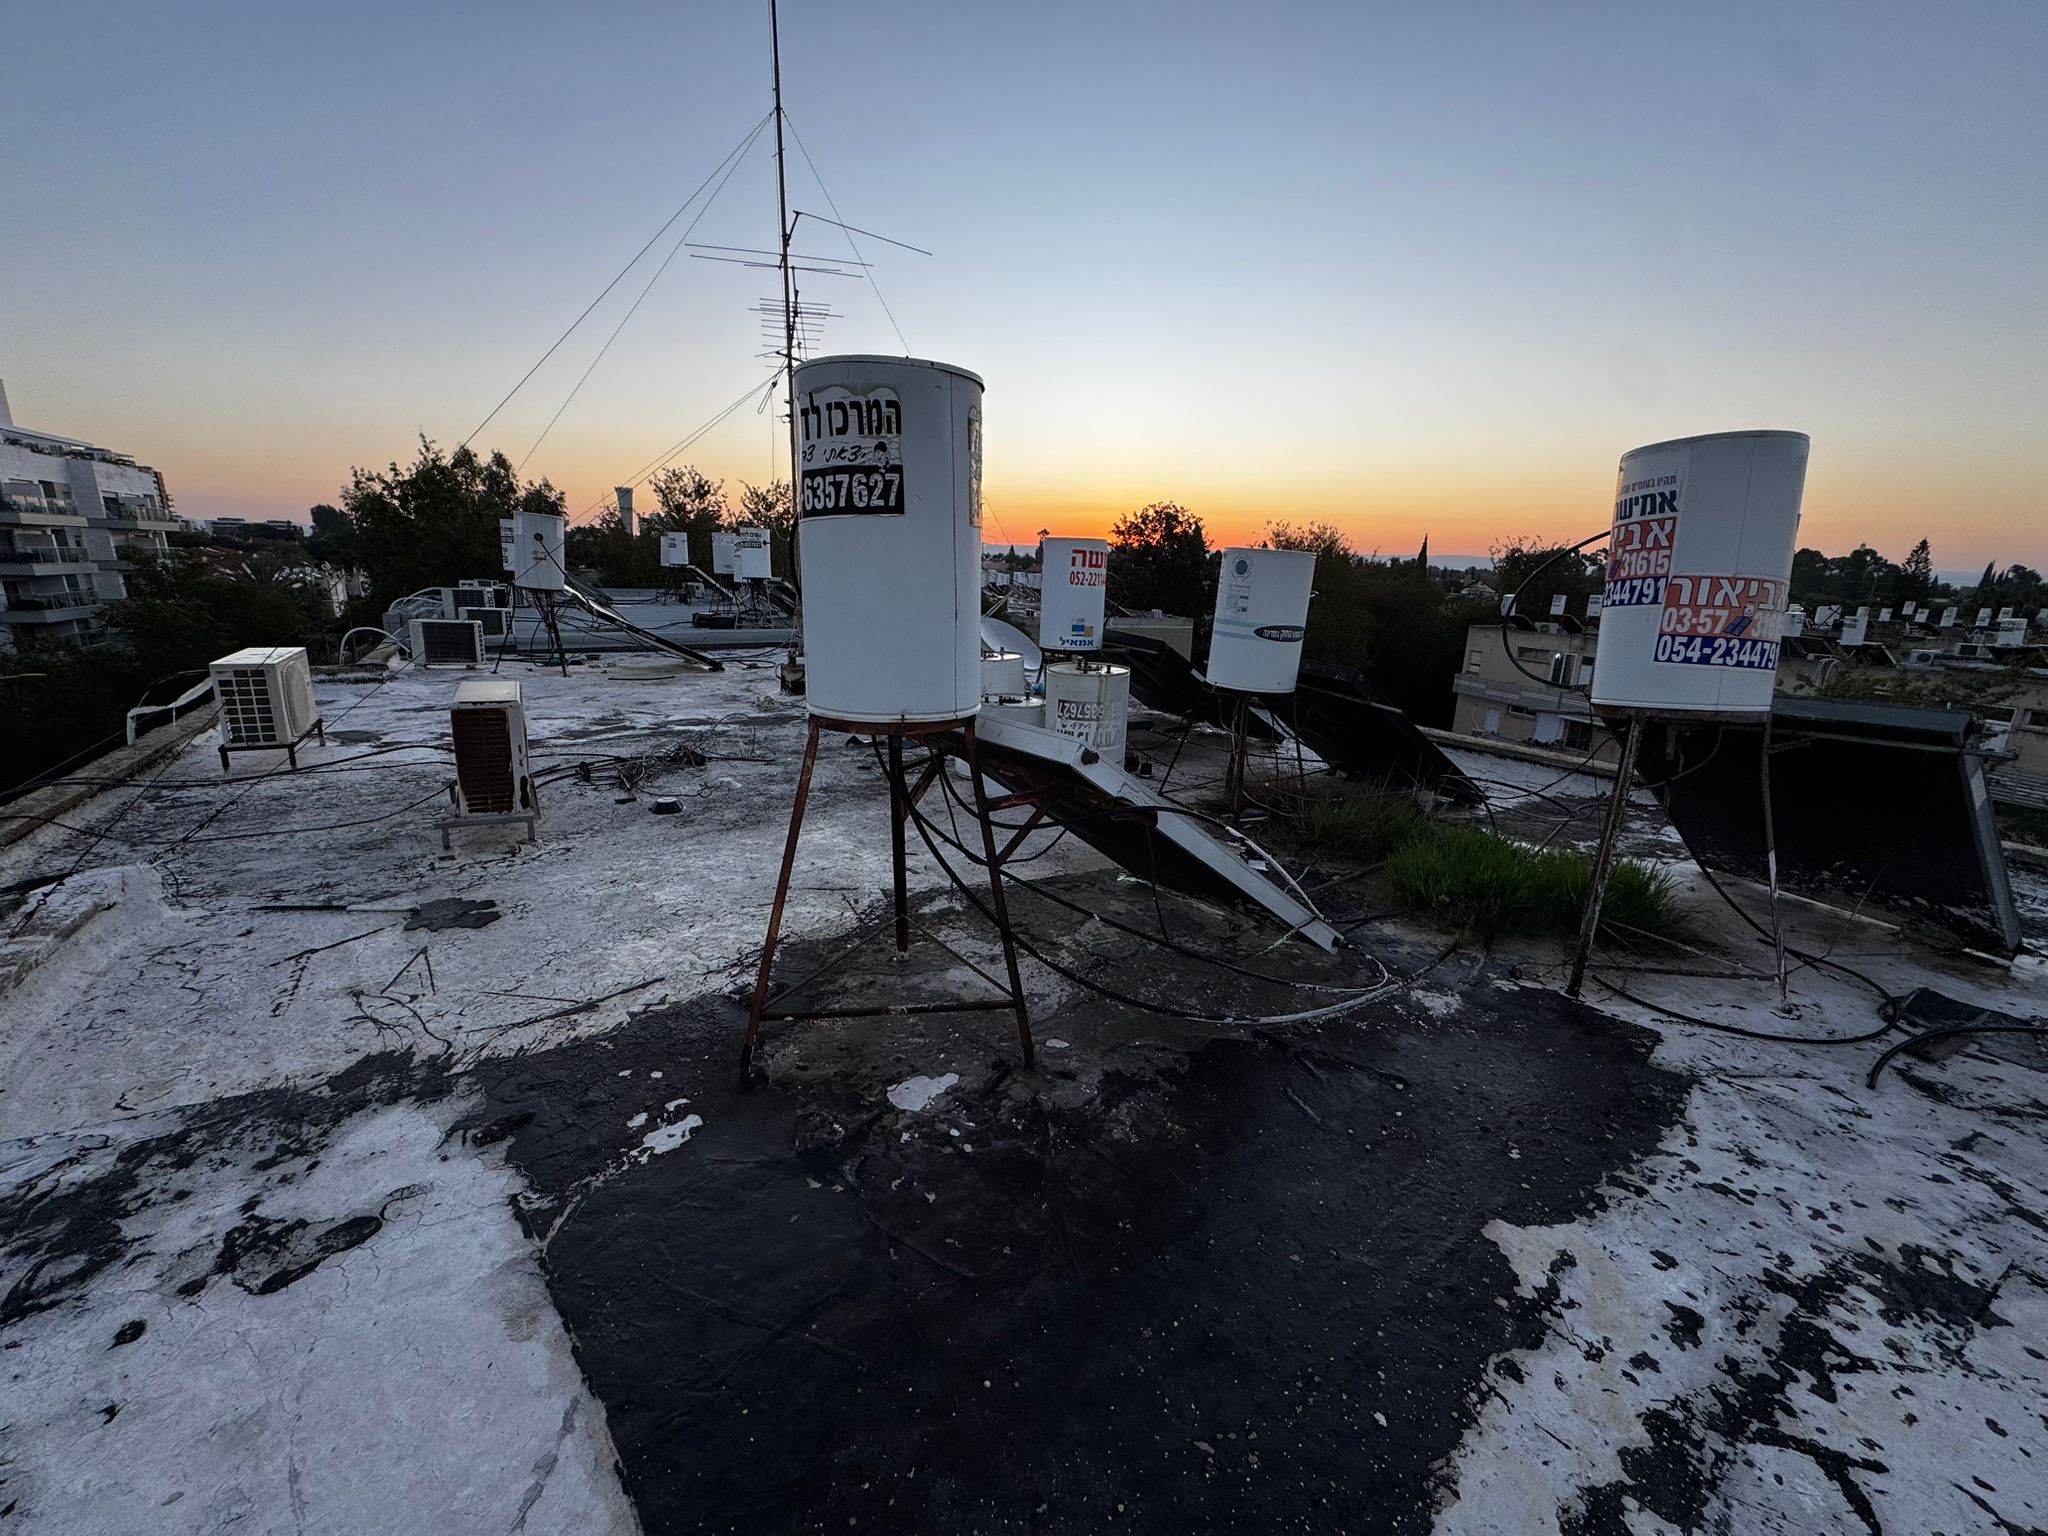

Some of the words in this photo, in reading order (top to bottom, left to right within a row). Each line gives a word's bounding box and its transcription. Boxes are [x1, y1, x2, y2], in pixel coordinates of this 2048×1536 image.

[826, 399, 902, 437] המרכז
[1620, 550, 1671, 578] 31615
[1670, 576, 1788, 612] אביאור
[1662, 606, 1730, 635] 03-57
